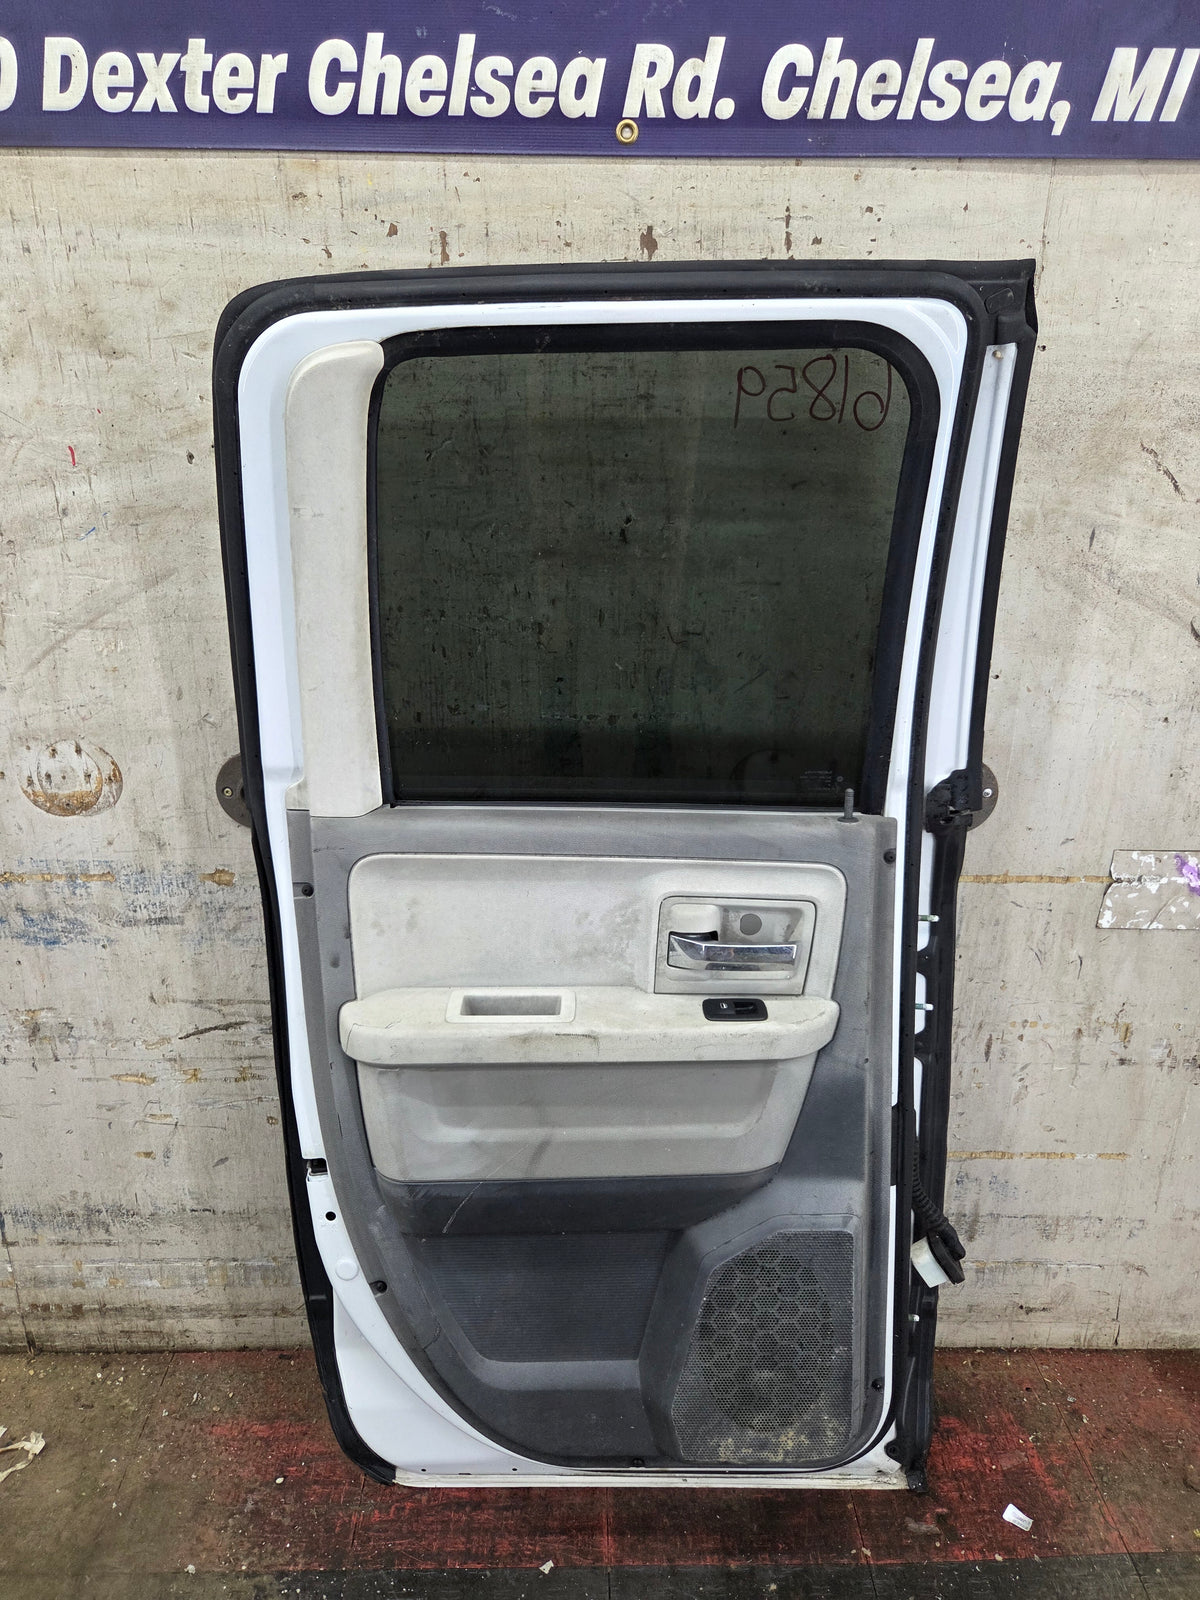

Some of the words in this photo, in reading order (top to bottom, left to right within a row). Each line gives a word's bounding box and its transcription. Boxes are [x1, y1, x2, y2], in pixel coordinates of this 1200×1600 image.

[43, 37, 289, 115] Dexter
[309, 32, 607, 120] Chelsea
[622, 36, 735, 120] Rd.
[762, 37, 1070, 136] Chelsea,
[1091, 47, 1200, 123] MI
